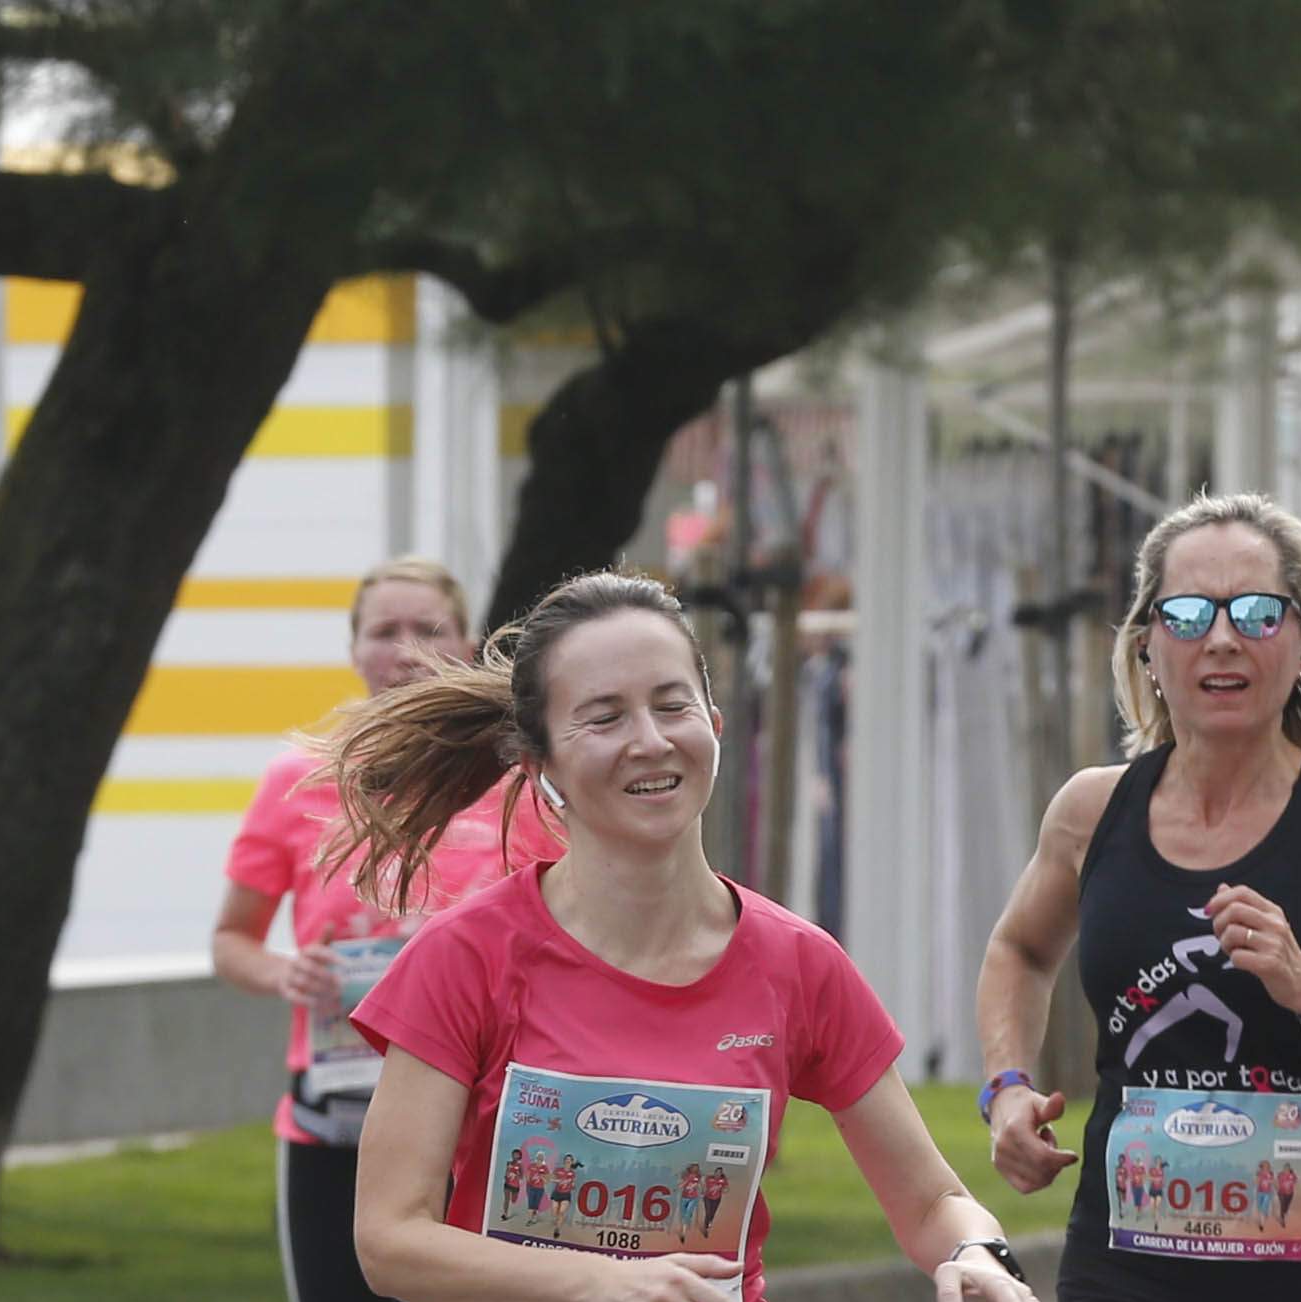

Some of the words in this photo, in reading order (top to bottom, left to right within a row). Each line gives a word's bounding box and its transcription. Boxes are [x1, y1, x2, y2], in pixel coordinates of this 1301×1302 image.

[732, 1033, 774, 1049] asics
[1186, 1069, 1228, 1090] por
[519, 1091, 560, 1110] SUMA
[718, 1103, 743, 1122] 20
[583, 1111, 680, 1137] ASTURIANA
[1167, 1115, 1248, 1137] ASTURIANA
[577, 1180, 672, 1223] 016
[1167, 1178, 1248, 1213] 016
[1183, 1220, 1223, 1236] 4466
[596, 1230, 641, 1250] 1088
[1133, 1234, 1175, 1250] CARRERA
[1176, 1239, 1192, 1252] DE
[1193, 1241, 1206, 1253] LA
[1207, 1241, 1244, 1254] MUJER
[1253, 1240, 1285, 1256] GIJÓN
